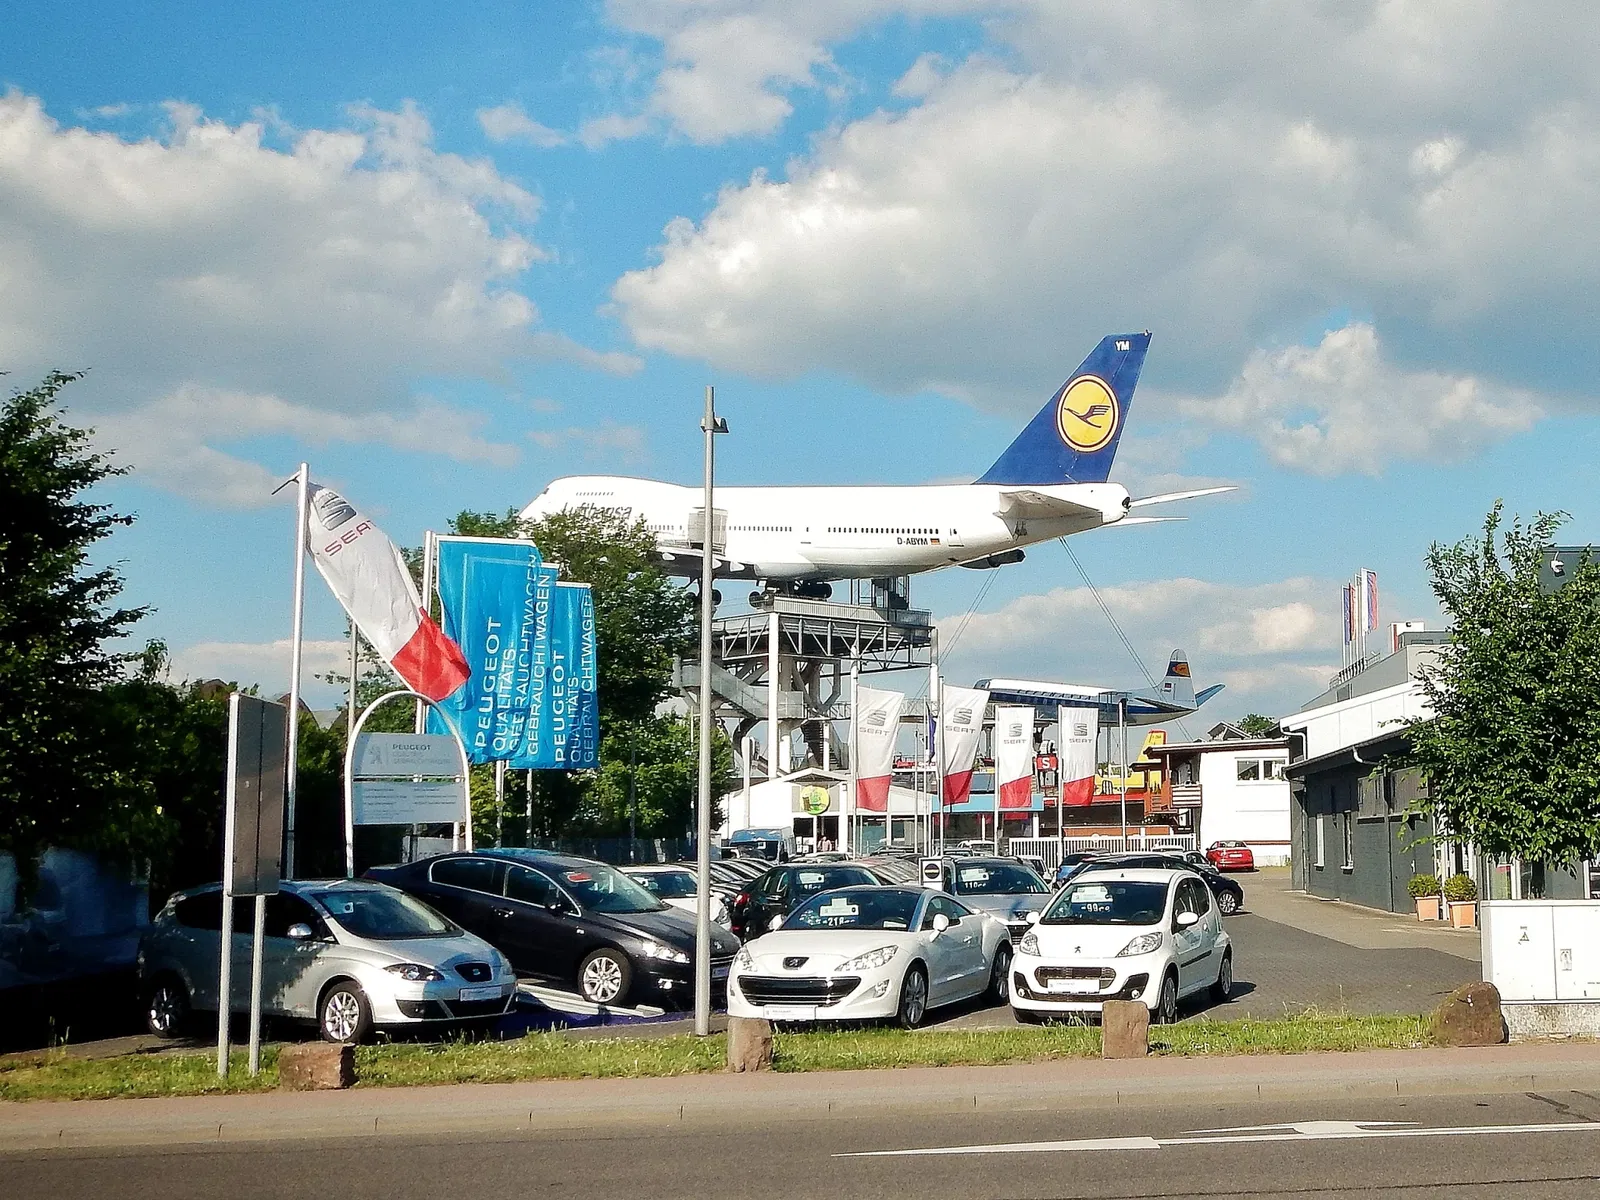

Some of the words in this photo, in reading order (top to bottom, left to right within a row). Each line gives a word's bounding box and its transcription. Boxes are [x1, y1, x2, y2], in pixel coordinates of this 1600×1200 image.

[1115, 340, 1130, 351] YM
[897, 537, 928, 546] D-ABYM
[475, 617, 501, 748] PEUGEOT
[552, 650, 567, 763] PEUGEOT
[859, 726, 890, 737] SEAT
[945, 725, 976, 734] SEAT
[392, 743, 432, 751] PEUGEOT
[1041, 757, 1051, 769] S
